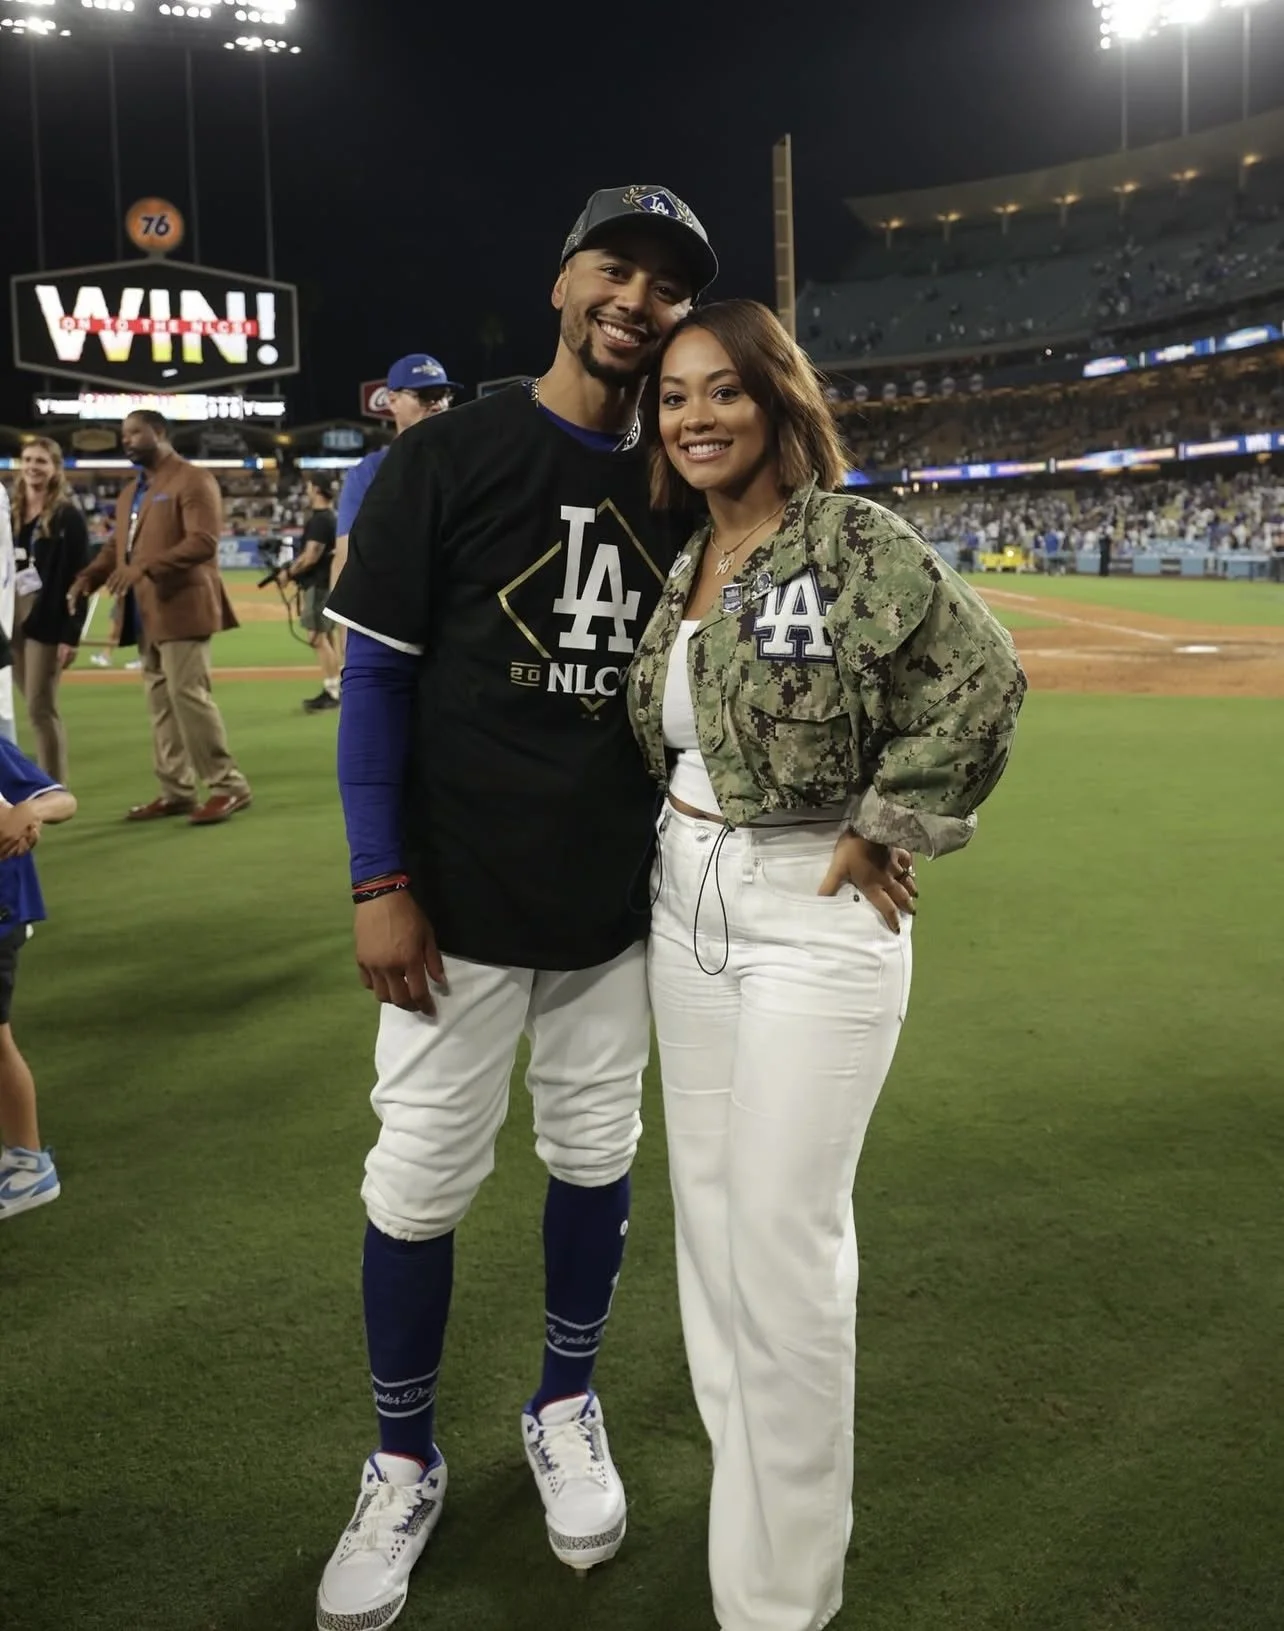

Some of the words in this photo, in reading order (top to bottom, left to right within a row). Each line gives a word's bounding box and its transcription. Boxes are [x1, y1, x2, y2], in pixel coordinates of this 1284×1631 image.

[650, 196, 669, 215] LA
[142, 215, 170, 237] 76
[35, 285, 279, 365] WIN!
[60, 316, 92, 331] ON
[104, 317, 129, 332] TO
[141, 318, 181, 333] THE
[552, 504, 641, 653] LA
